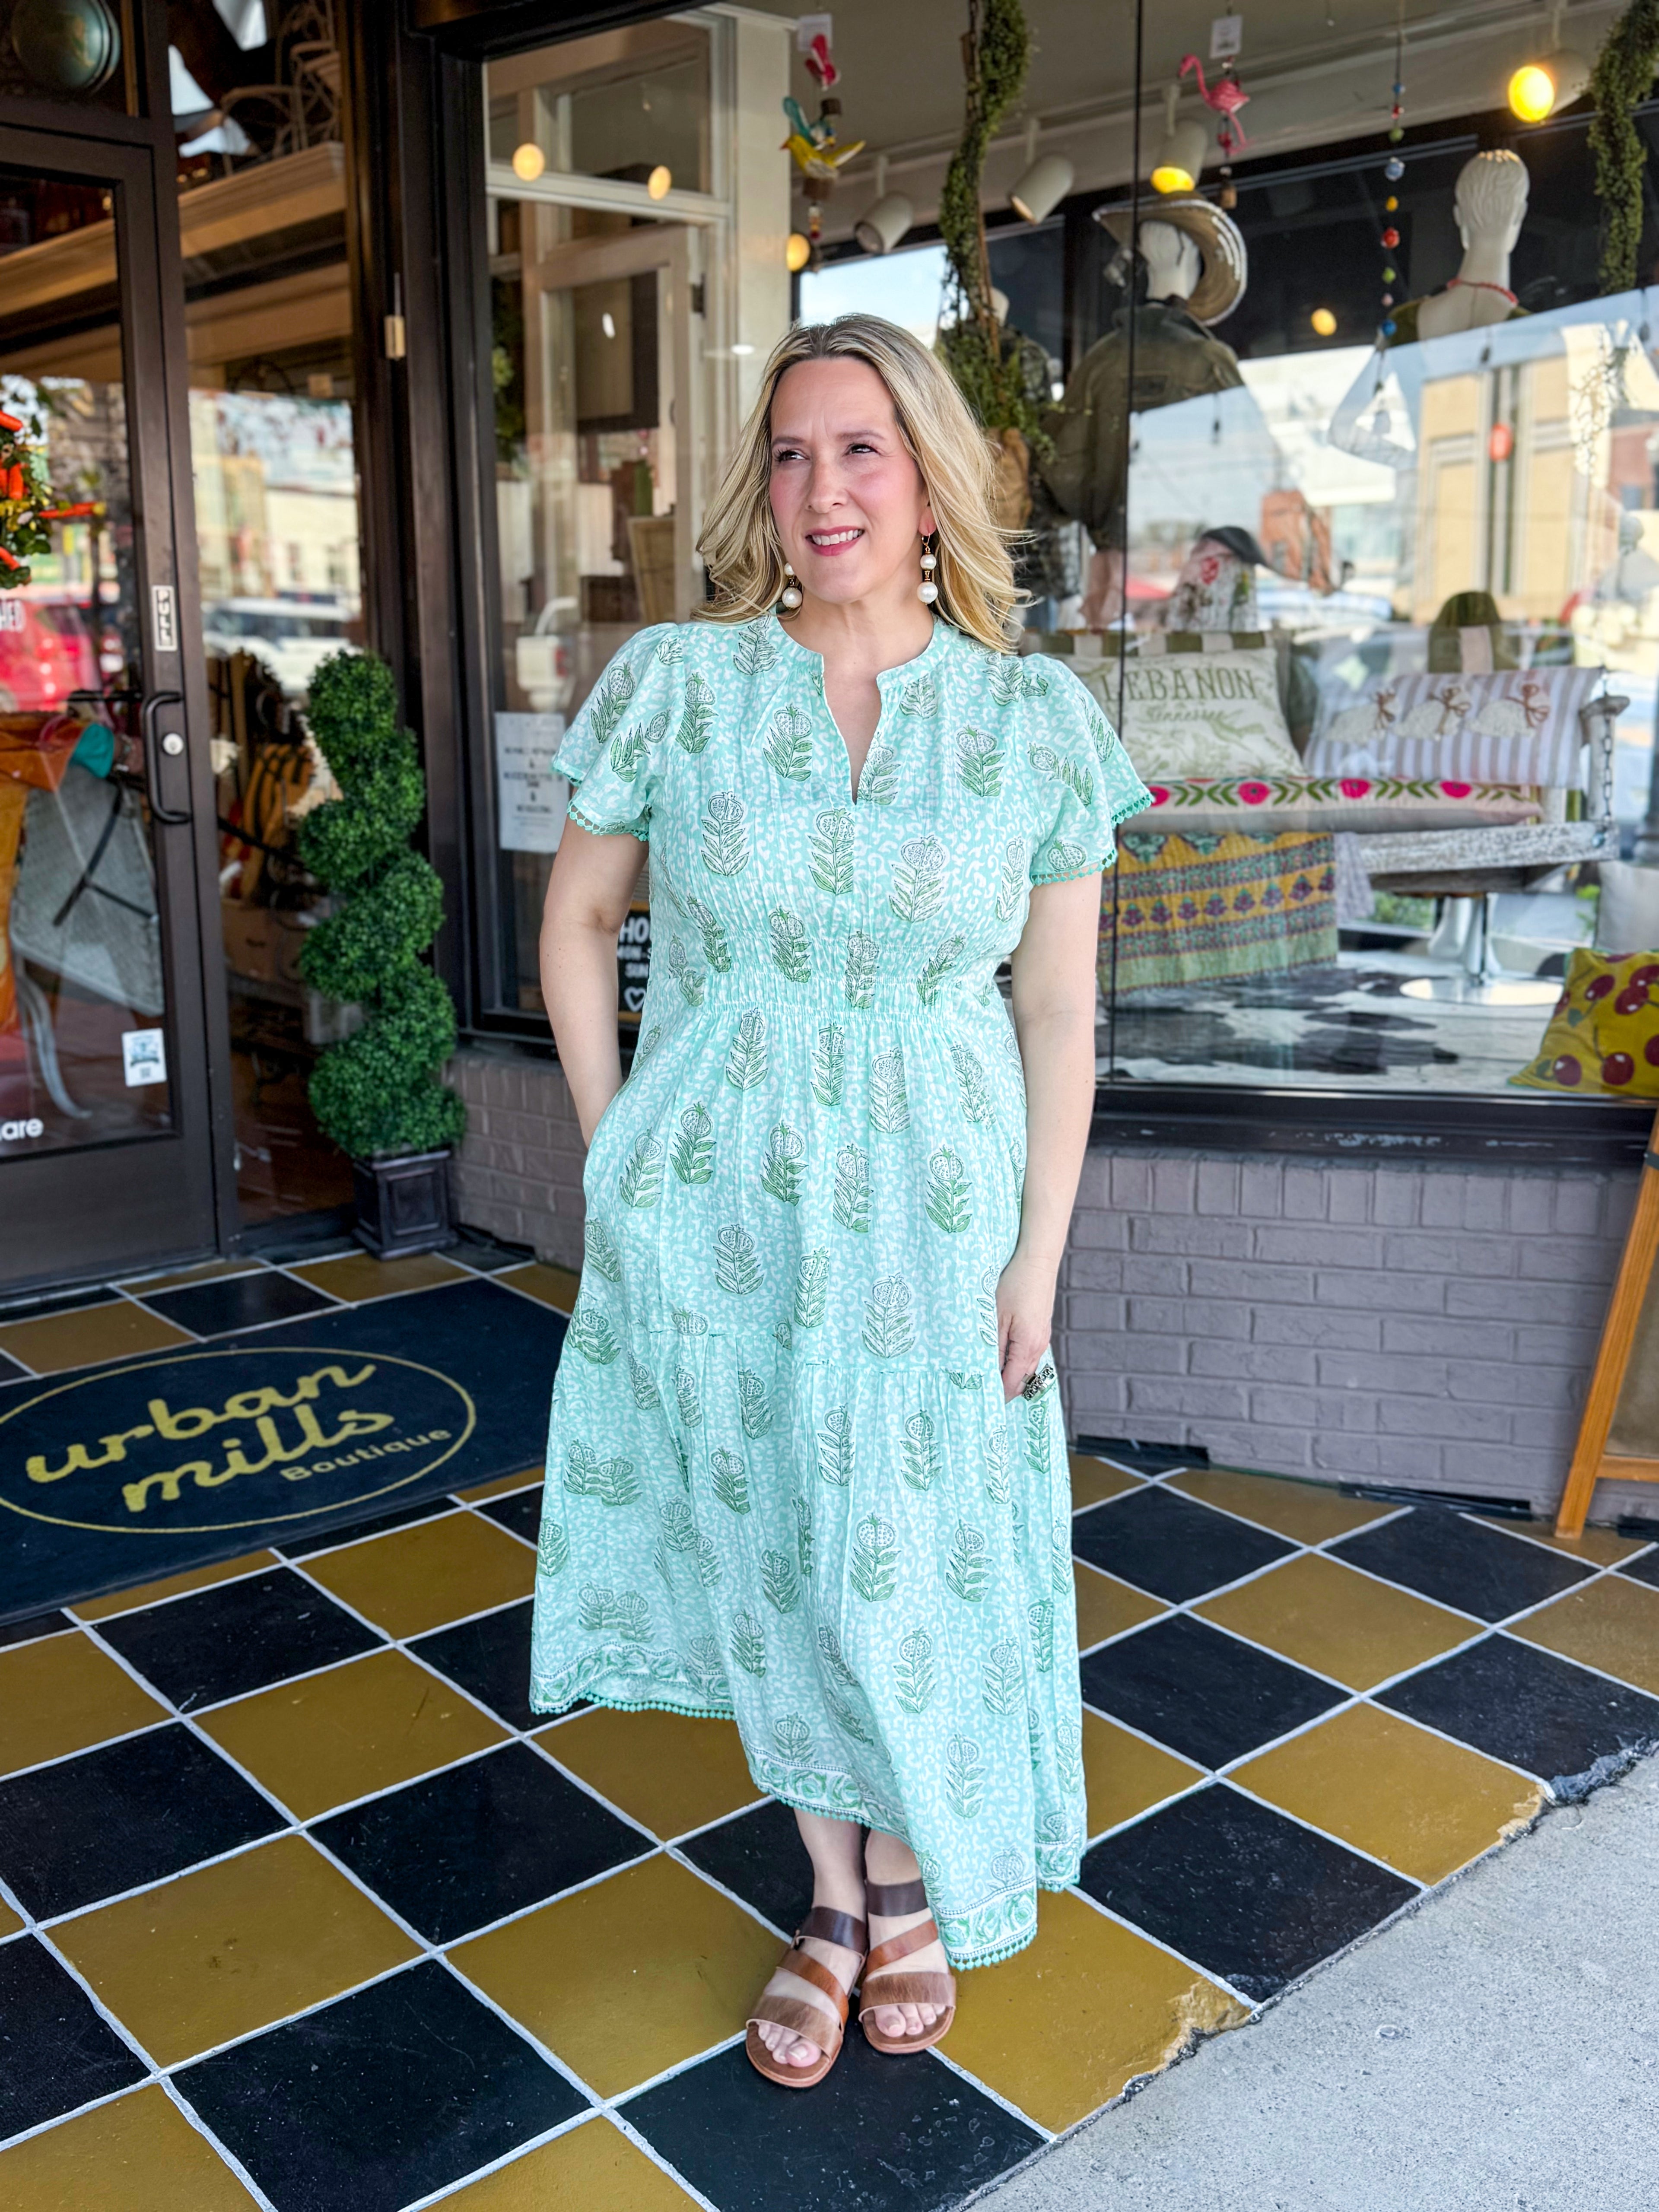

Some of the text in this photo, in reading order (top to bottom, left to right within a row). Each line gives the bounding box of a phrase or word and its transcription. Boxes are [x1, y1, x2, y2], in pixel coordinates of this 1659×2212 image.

[157, 590, 171, 646] PULL
[1101, 667, 1259, 701] LEBANON
[0, 1118, 44, 1141] are
[26, 1363, 376, 1483] urban
[122, 1404, 394, 1512] mills
[280, 1430, 452, 1481] Boutique
